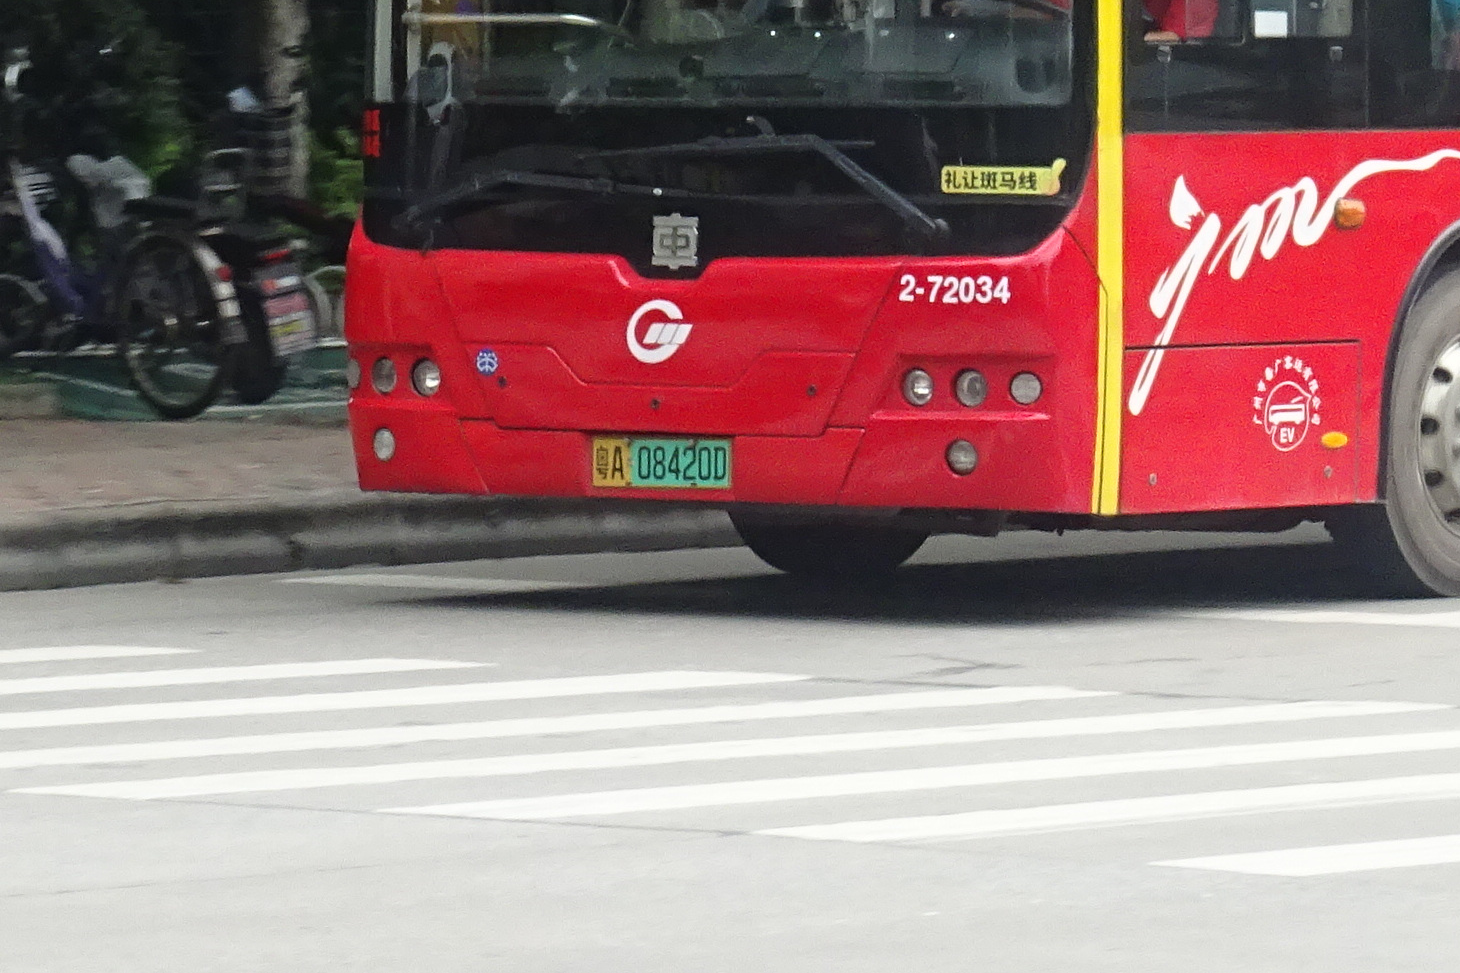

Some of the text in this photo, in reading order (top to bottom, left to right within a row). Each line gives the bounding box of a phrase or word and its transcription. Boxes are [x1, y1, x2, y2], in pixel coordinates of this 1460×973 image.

[944, 169, 1037, 191] 礼让斑马线
[899, 275, 1011, 305] 2-72034
[1279, 426, 1296, 444] EV
